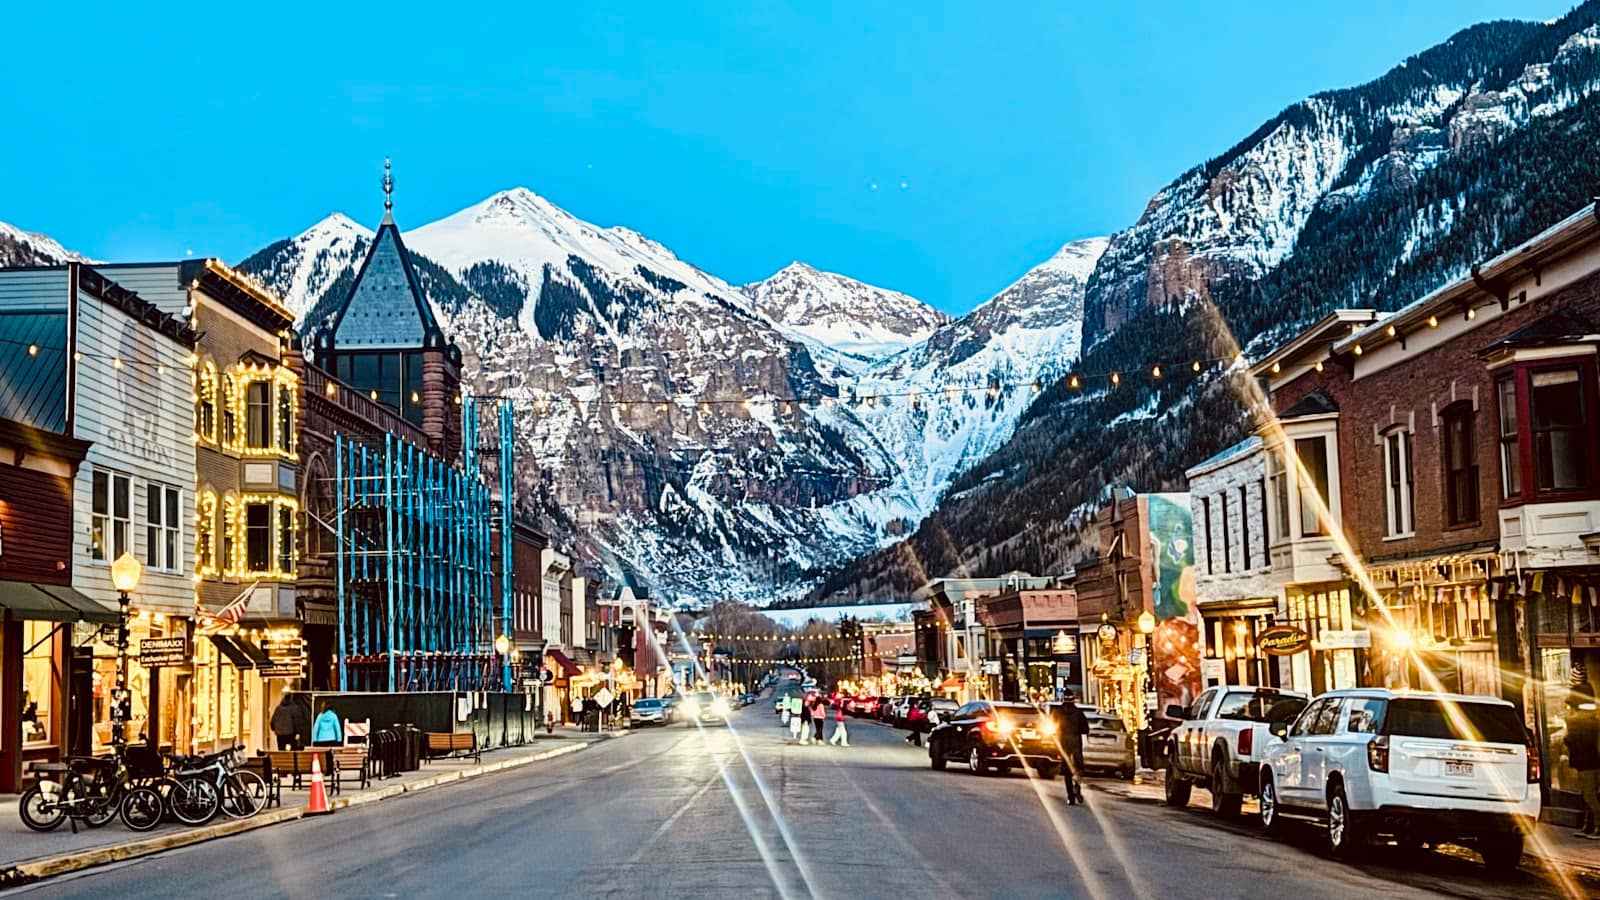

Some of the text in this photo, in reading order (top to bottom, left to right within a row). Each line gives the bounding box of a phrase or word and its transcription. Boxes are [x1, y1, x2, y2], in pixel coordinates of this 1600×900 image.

[107, 429, 171, 467] SALOON
[141, 640, 183, 649] DENIMAXX
[1260, 632, 1307, 649] Paradise
